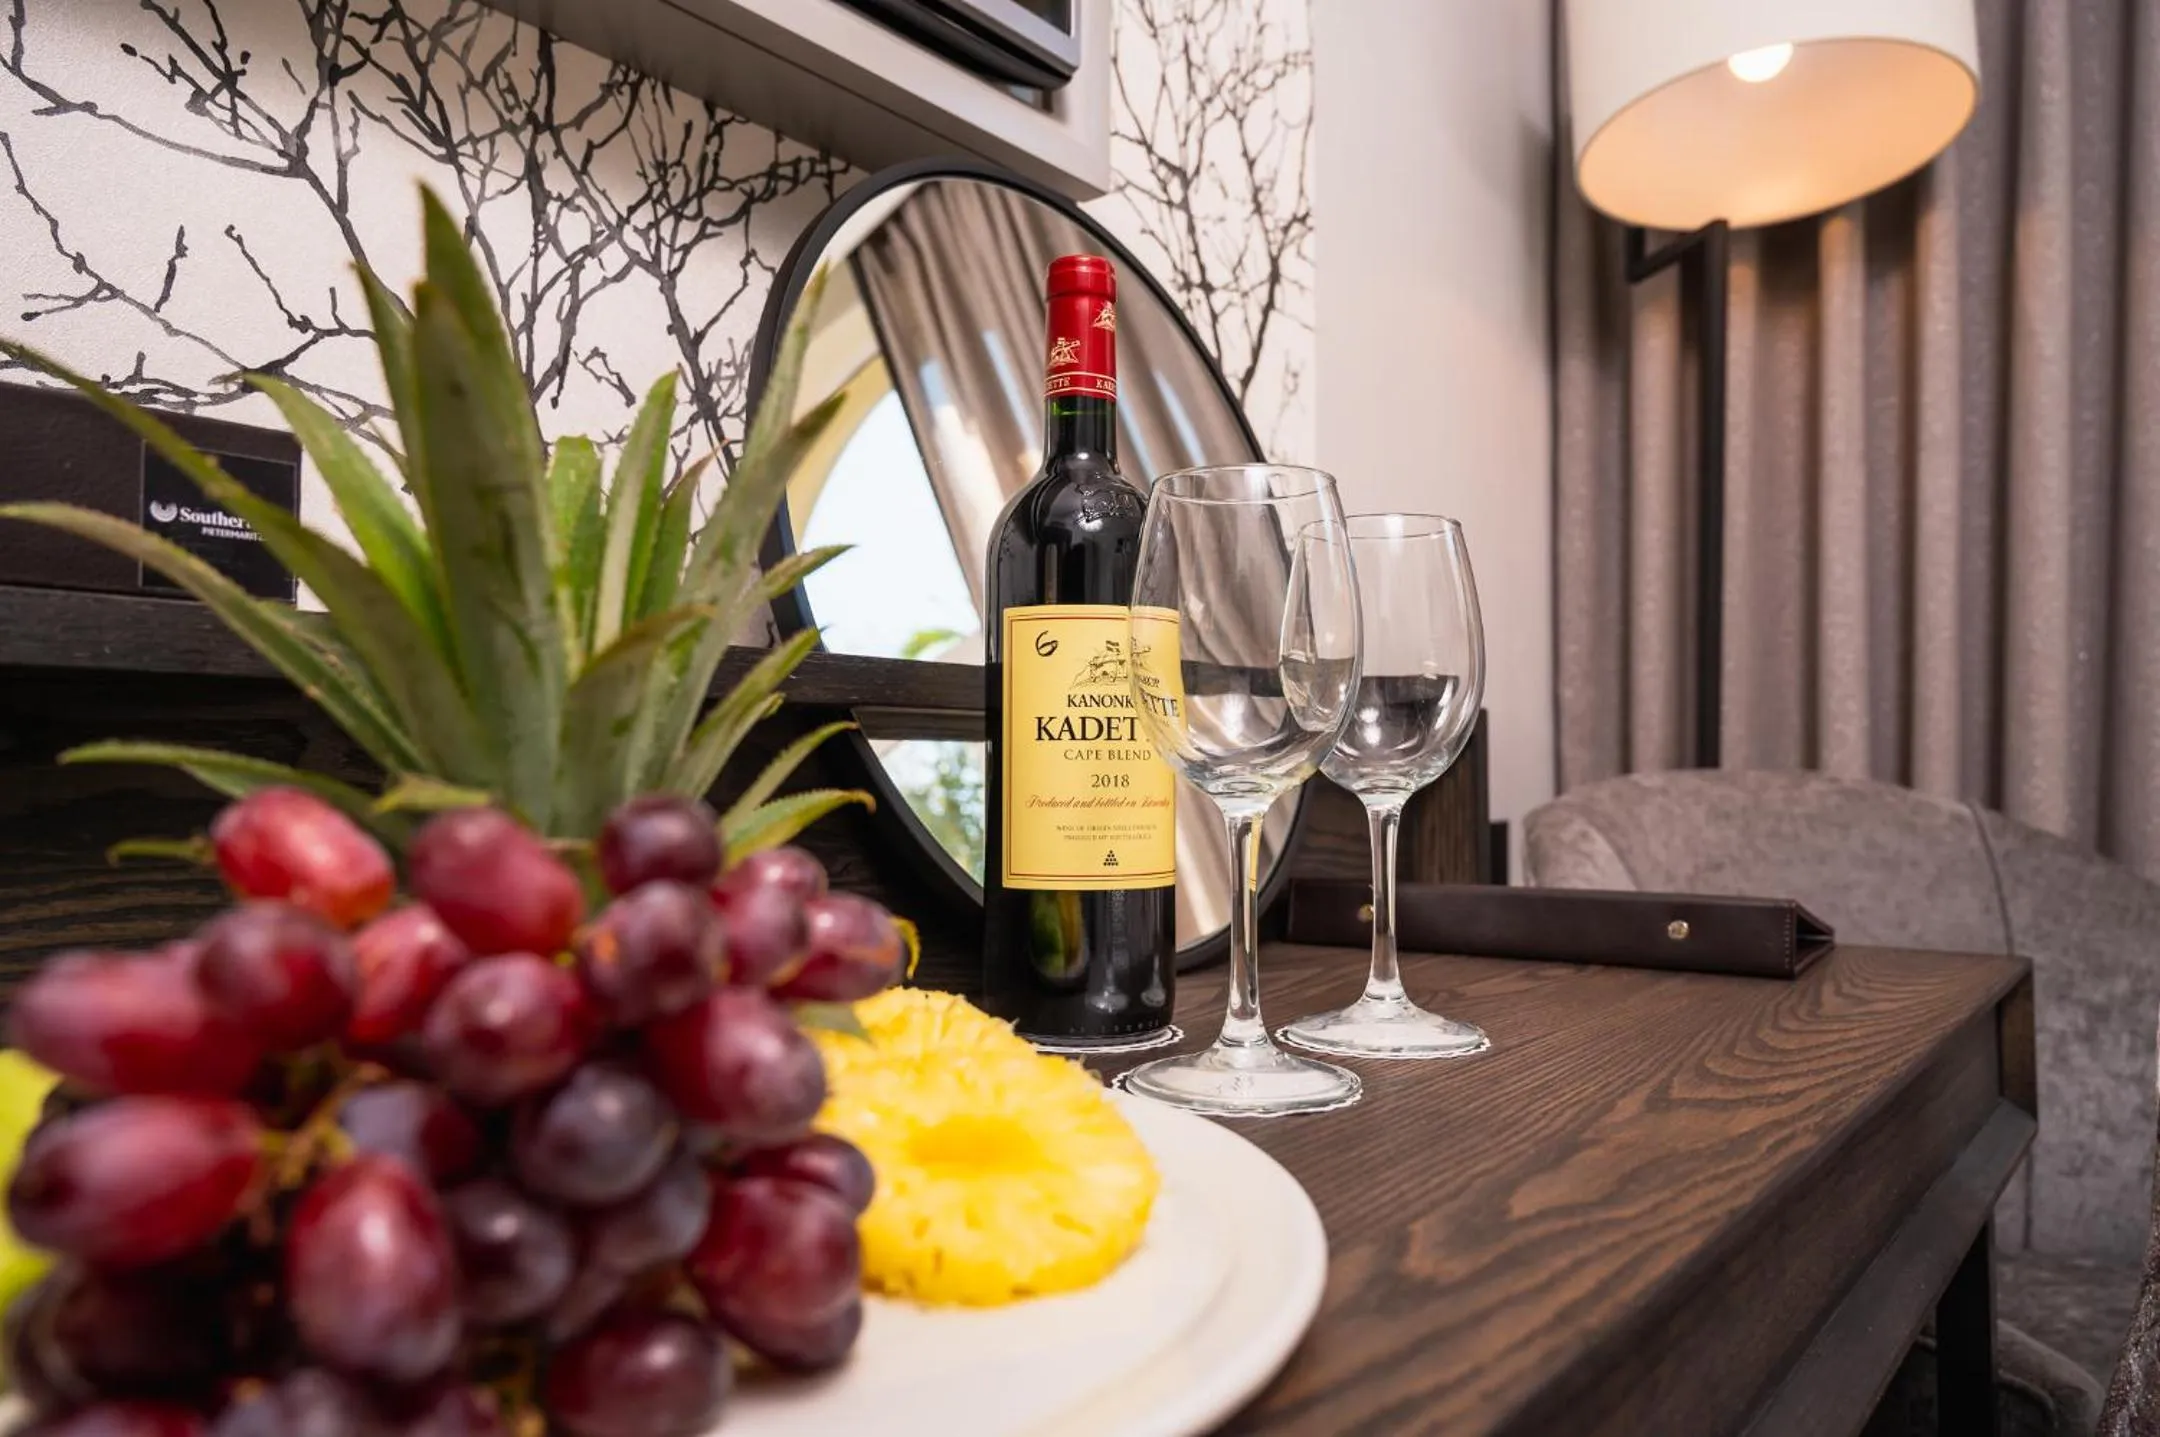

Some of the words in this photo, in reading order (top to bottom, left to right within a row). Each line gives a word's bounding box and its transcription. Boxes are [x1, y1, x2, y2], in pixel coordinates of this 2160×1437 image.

[1067, 694, 1134, 708] KANONK
[1034, 715, 1140, 741] KADET
[1063, 749, 1102, 760] CAPE
[1108, 749, 1151, 760] BLEND
[1091, 774, 1130, 788] 2018
[1025, 794, 1075, 808] Produced
[1073, 796, 1096, 808] and
[1094, 796, 1127, 808] bottled
